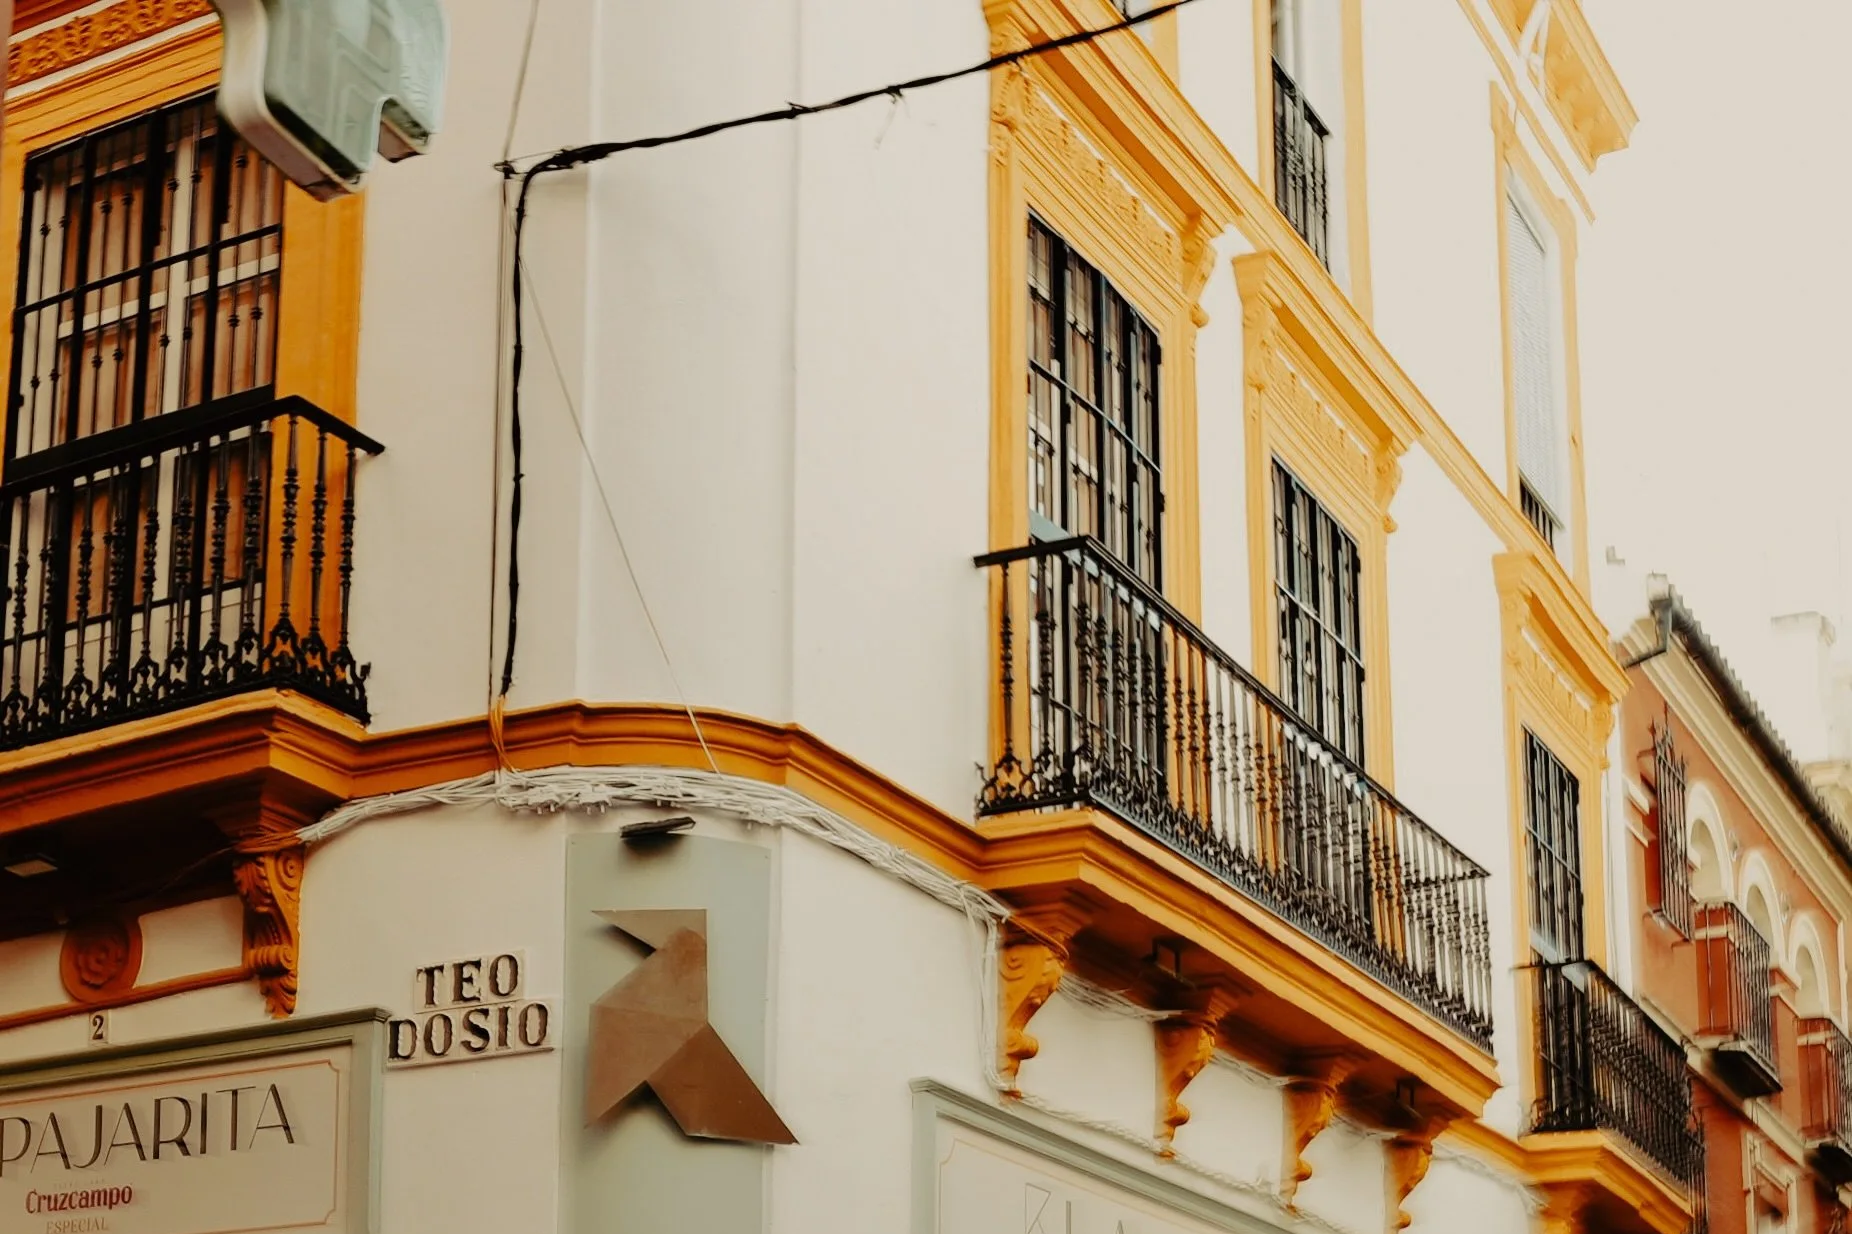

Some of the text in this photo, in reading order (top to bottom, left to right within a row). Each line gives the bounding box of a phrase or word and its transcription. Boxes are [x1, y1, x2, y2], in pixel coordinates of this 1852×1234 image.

[416, 954, 519, 1007] TEO
[92, 1016, 104, 1040] 2
[388, 1003, 549, 1060] DOSIO
[0, 1083, 295, 1178] PAJARITA
[25, 1183, 133, 1214] Cruzcampo
[46, 1216, 109, 1234] ESPECIAL
